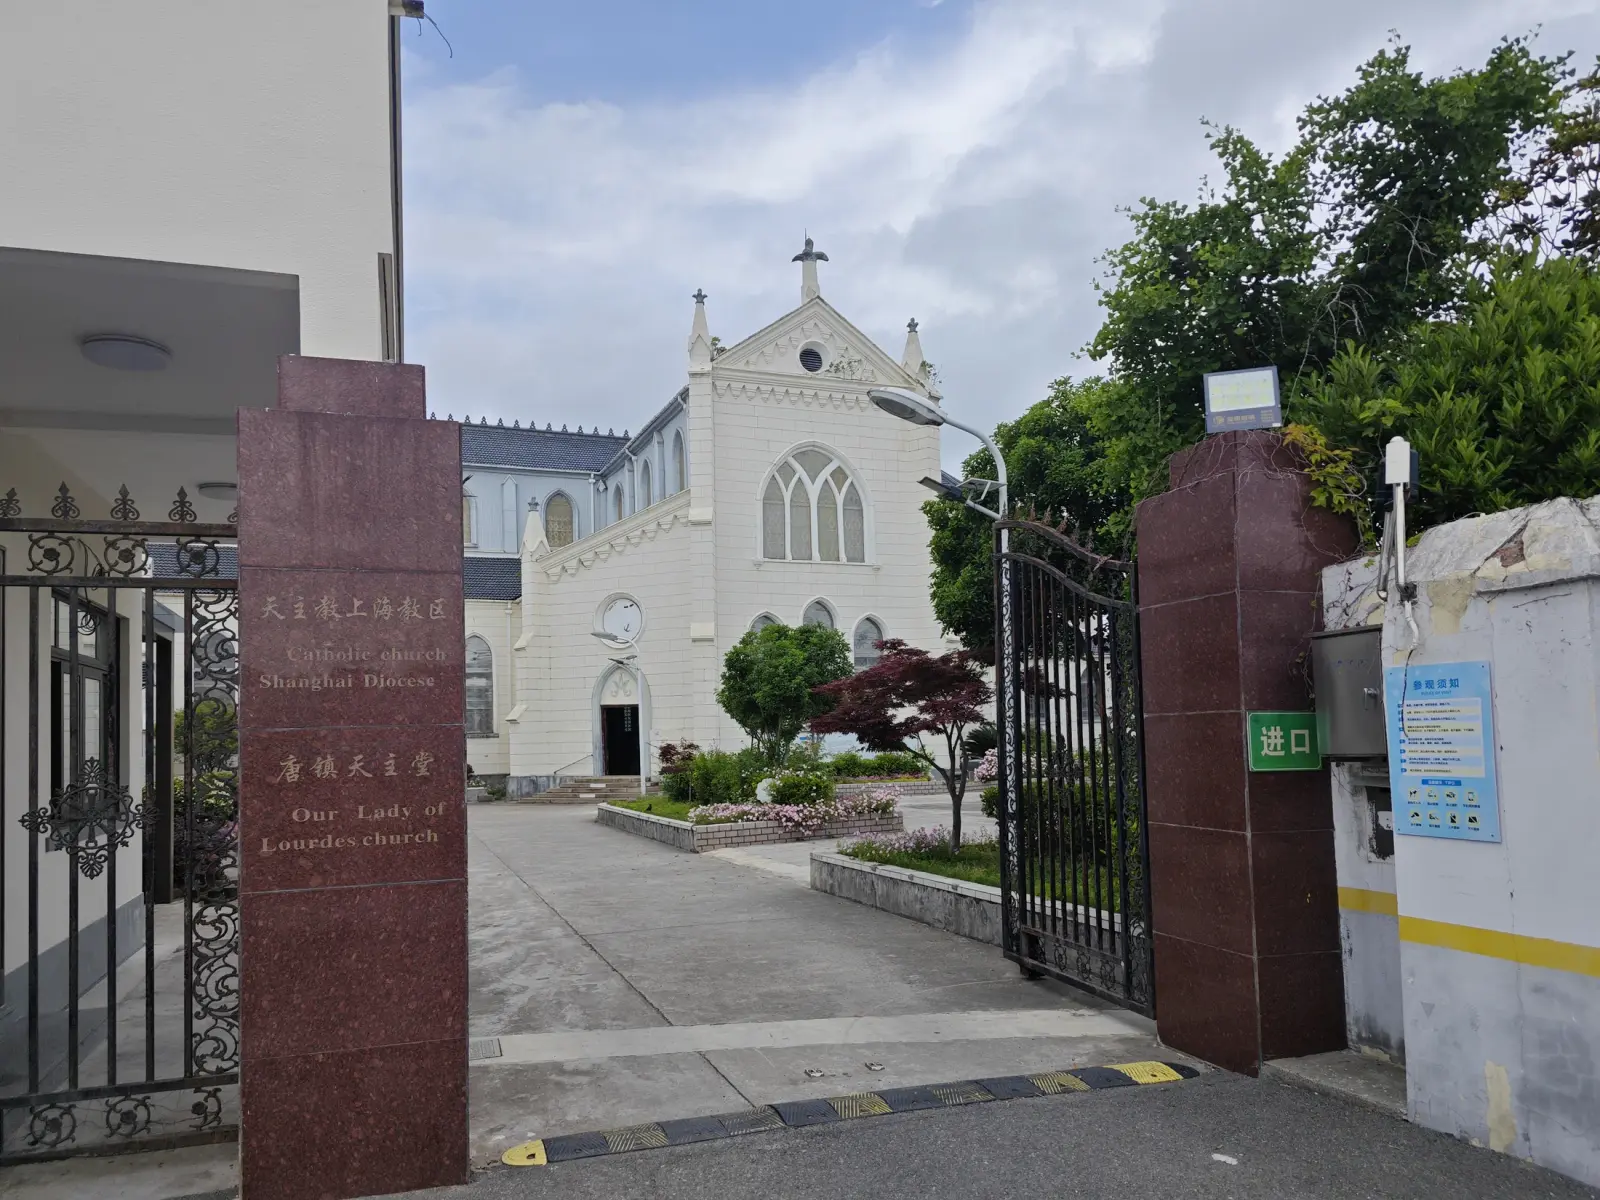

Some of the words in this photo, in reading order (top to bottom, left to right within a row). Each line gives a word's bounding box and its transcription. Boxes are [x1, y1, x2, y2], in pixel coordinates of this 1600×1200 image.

[261, 596, 448, 620] 天主教上海教区
[287, 647, 371, 662] Catholic
[380, 647, 446, 662] church
[259, 674, 353, 691] Shanghai
[363, 674, 435, 688] Diocese
[1413, 678, 1460, 691] 参观须知
[1260, 726, 1311, 756] 进口
[292, 808, 338, 822] Our
[357, 803, 413, 820] Lady
[425, 802, 446, 816] of
[261, 834, 356, 852] Lourdes
[362, 829, 439, 846] church
